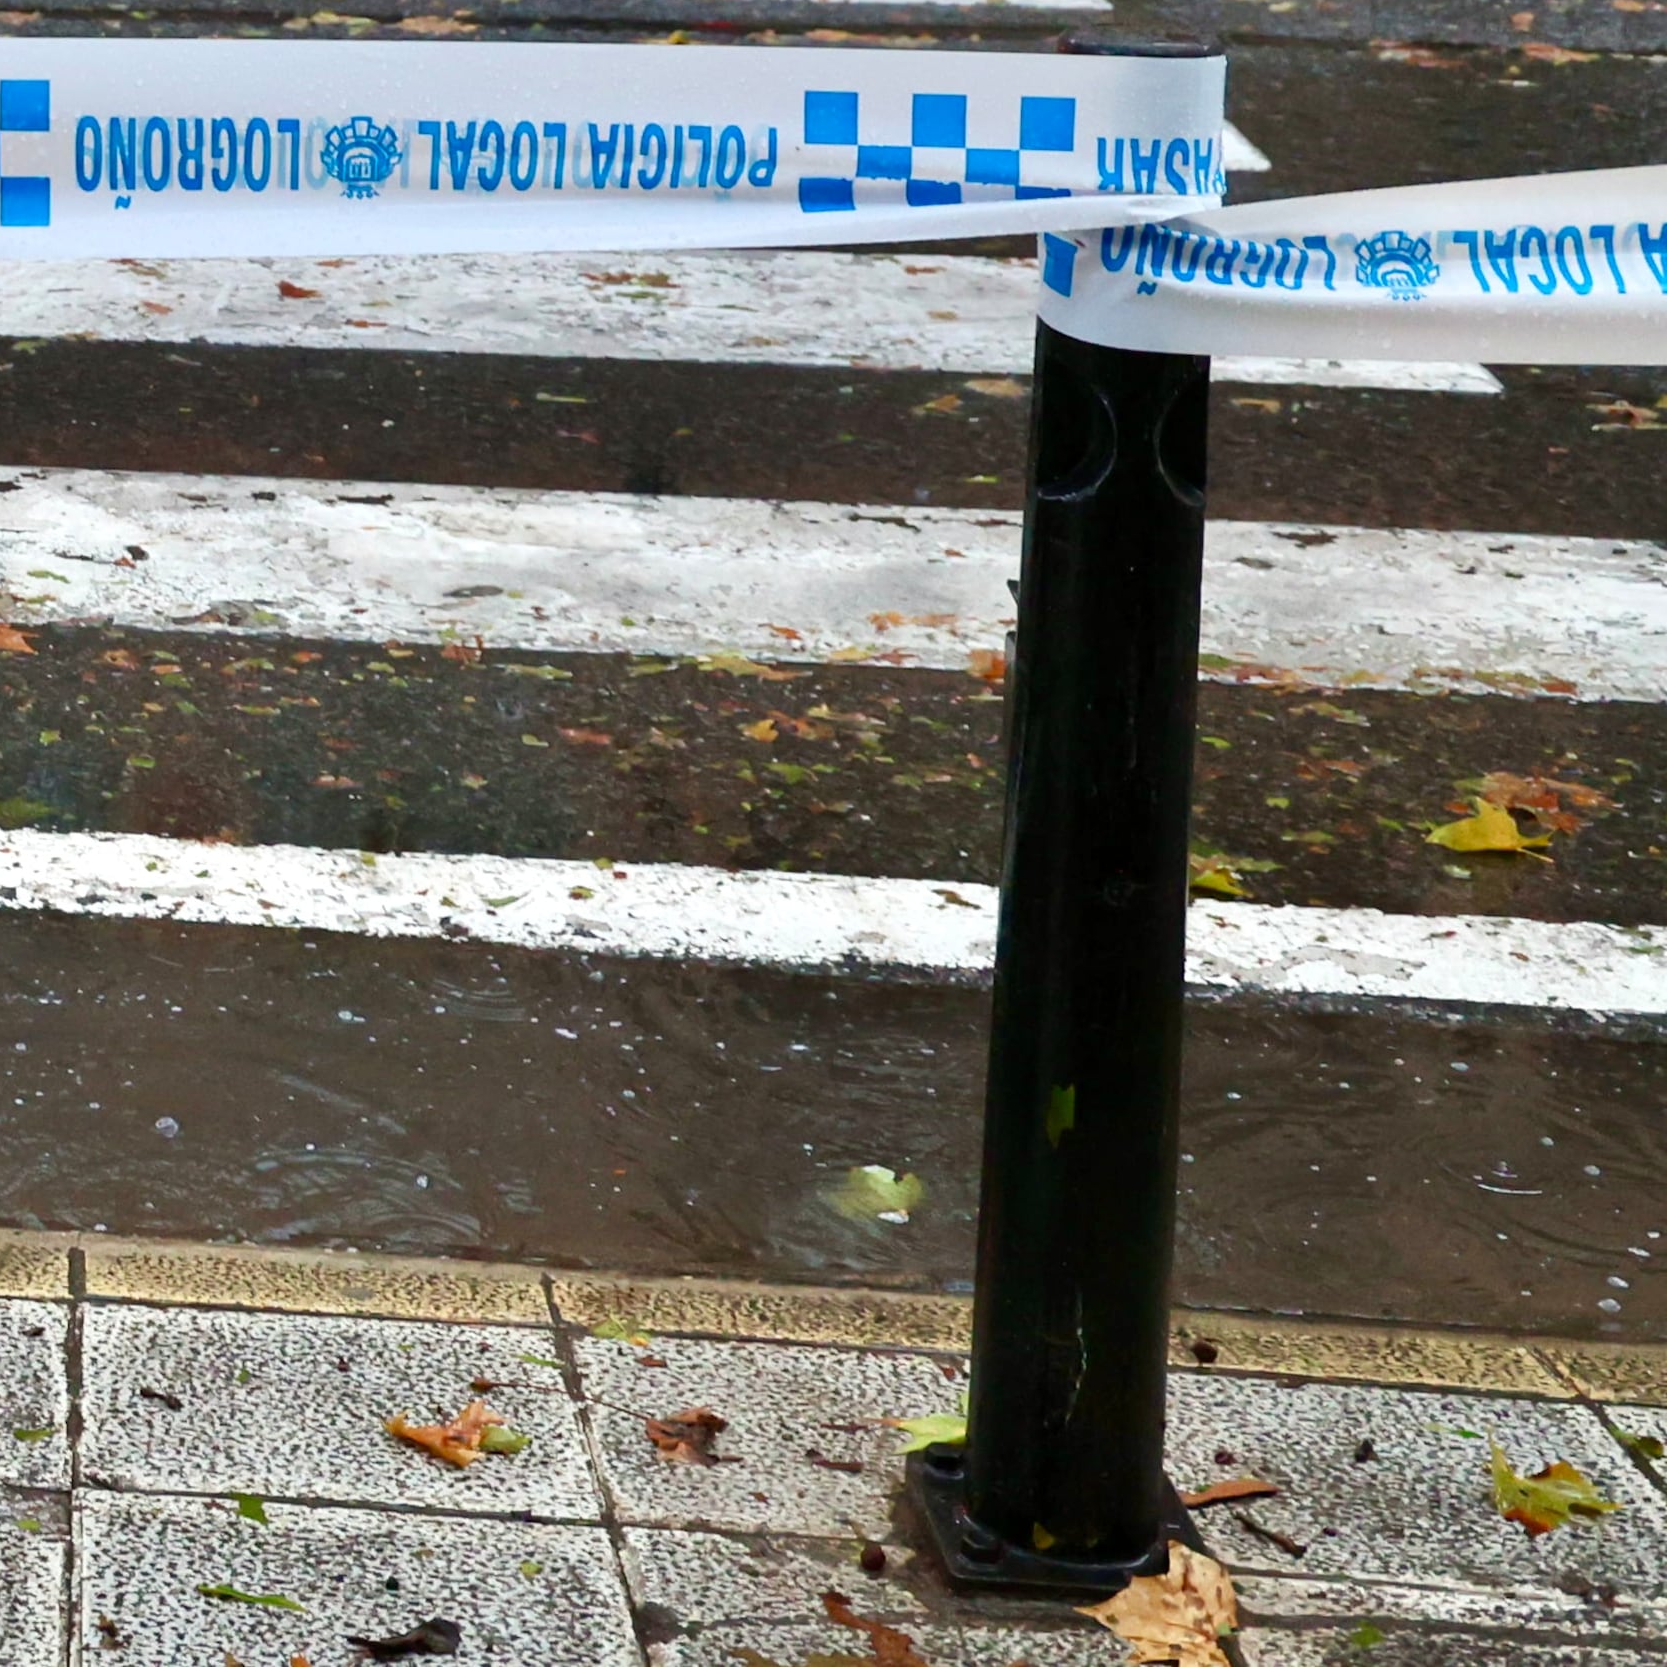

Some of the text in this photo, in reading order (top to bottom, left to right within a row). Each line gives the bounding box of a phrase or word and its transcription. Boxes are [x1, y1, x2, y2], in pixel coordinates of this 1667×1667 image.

[75, 116, 778, 209] POLICIA LOCAL LOGROÑO
[1102, 223, 1337, 295] LOGROÑO
[1453, 224, 1626, 295] LOCAL
